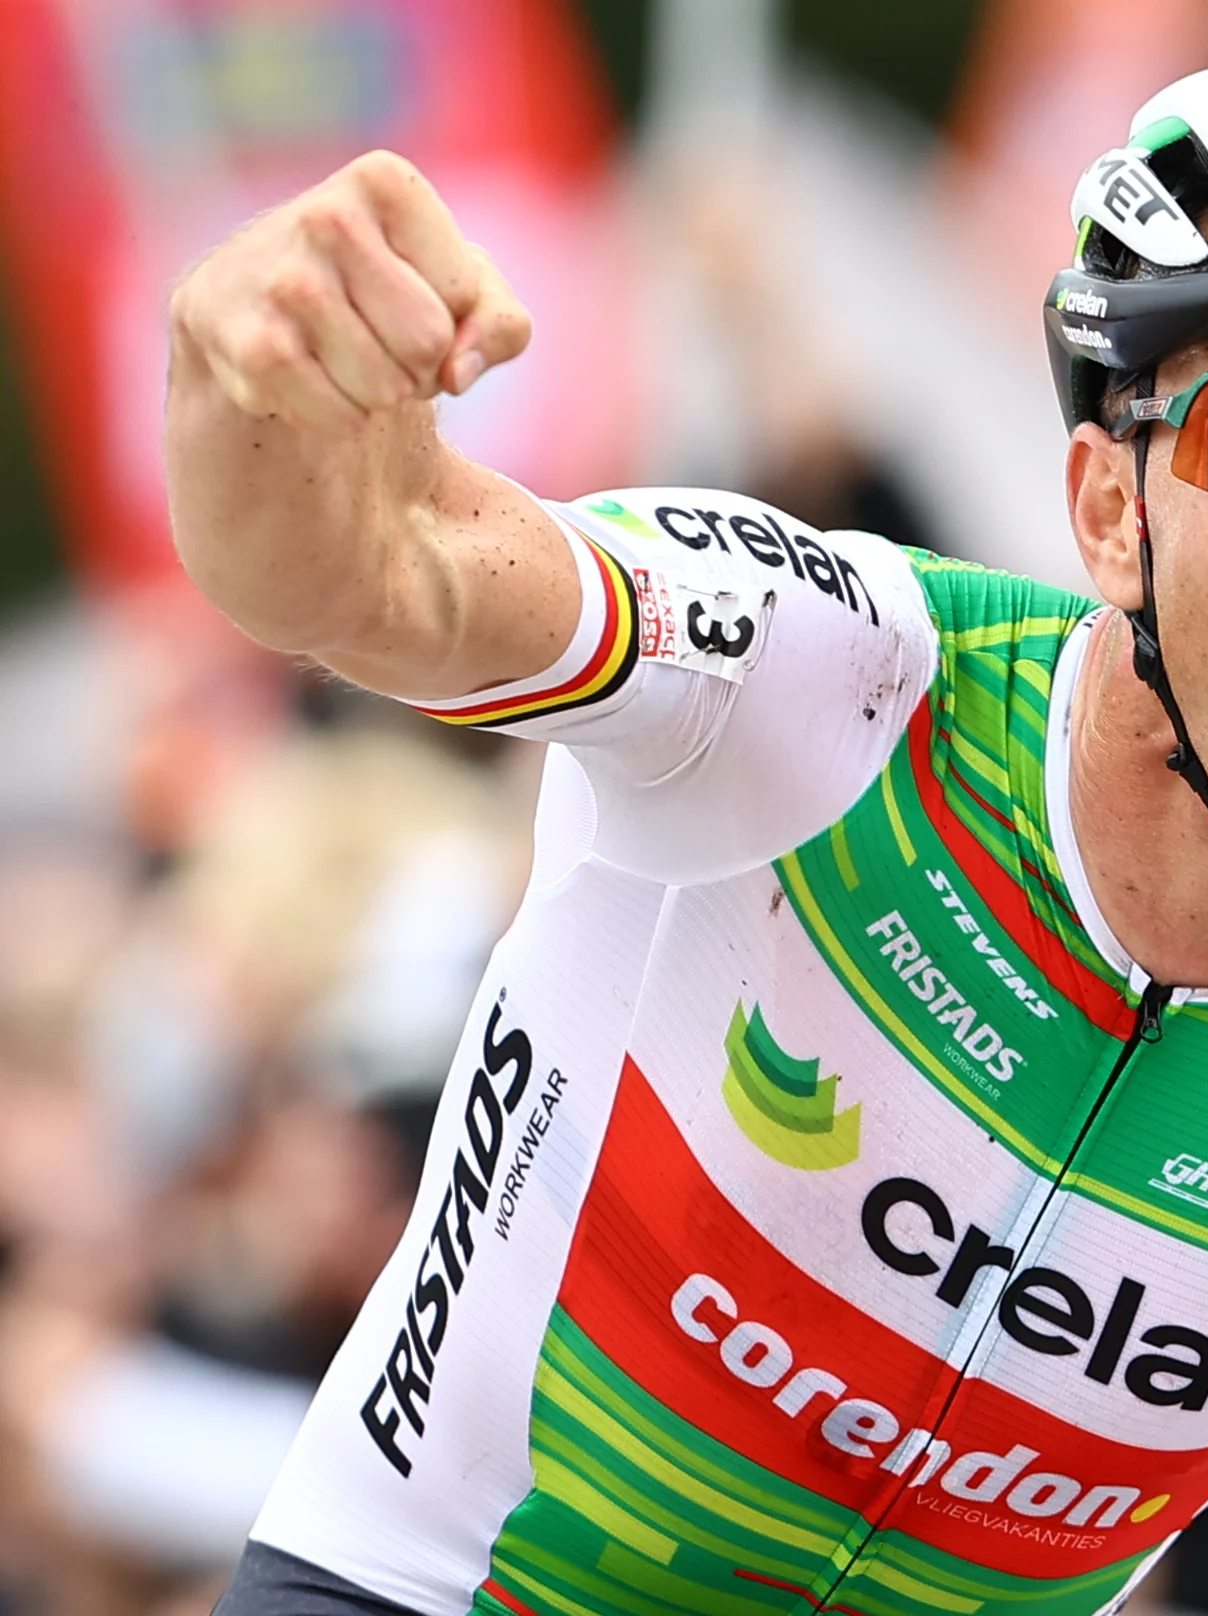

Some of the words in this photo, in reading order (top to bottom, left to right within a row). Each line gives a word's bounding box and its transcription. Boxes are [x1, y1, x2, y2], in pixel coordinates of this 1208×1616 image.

[1086, 159, 1180, 226] MET
[1066, 288, 1108, 318] crelan
[655, 505, 880, 628] crelan
[686, 599, 756, 659] 3
[924, 868, 1060, 1020] STEVENS
[942, 1042, 1002, 1101] WORKWEAR
[493, 1066, 569, 1242] WORKWEAR
[670, 1272, 1144, 1529] corendon
[914, 1491, 1108, 1551] VLIEGVAKANTIES
